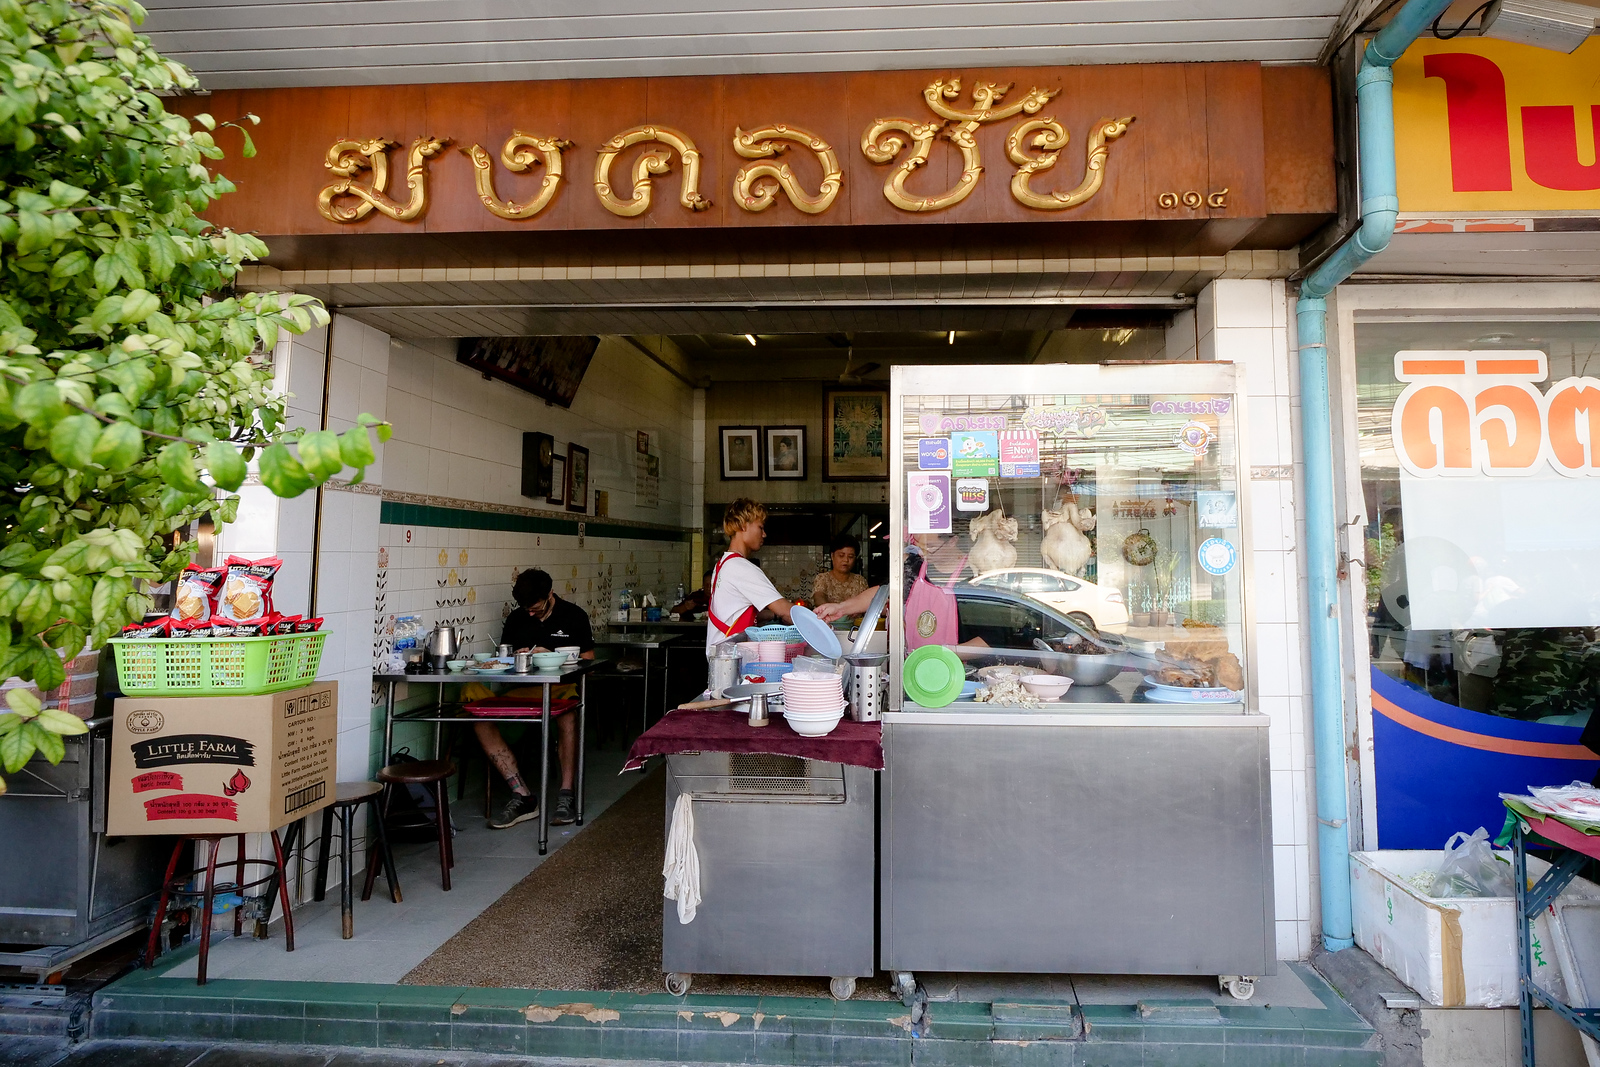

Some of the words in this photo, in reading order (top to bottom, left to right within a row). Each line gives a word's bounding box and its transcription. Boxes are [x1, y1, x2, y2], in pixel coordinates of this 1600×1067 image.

[317, 77, 1136, 222] มงคลชัย
[1013, 446, 1034, 454] Now
[406, 529, 412, 543] 9
[536, 536, 541, 547] 8
[287, 718, 306, 728] CARTON
[148, 742, 195, 756] LITTLE
[200, 740, 237, 753] FARM
[291, 767, 301, 775] Farm
